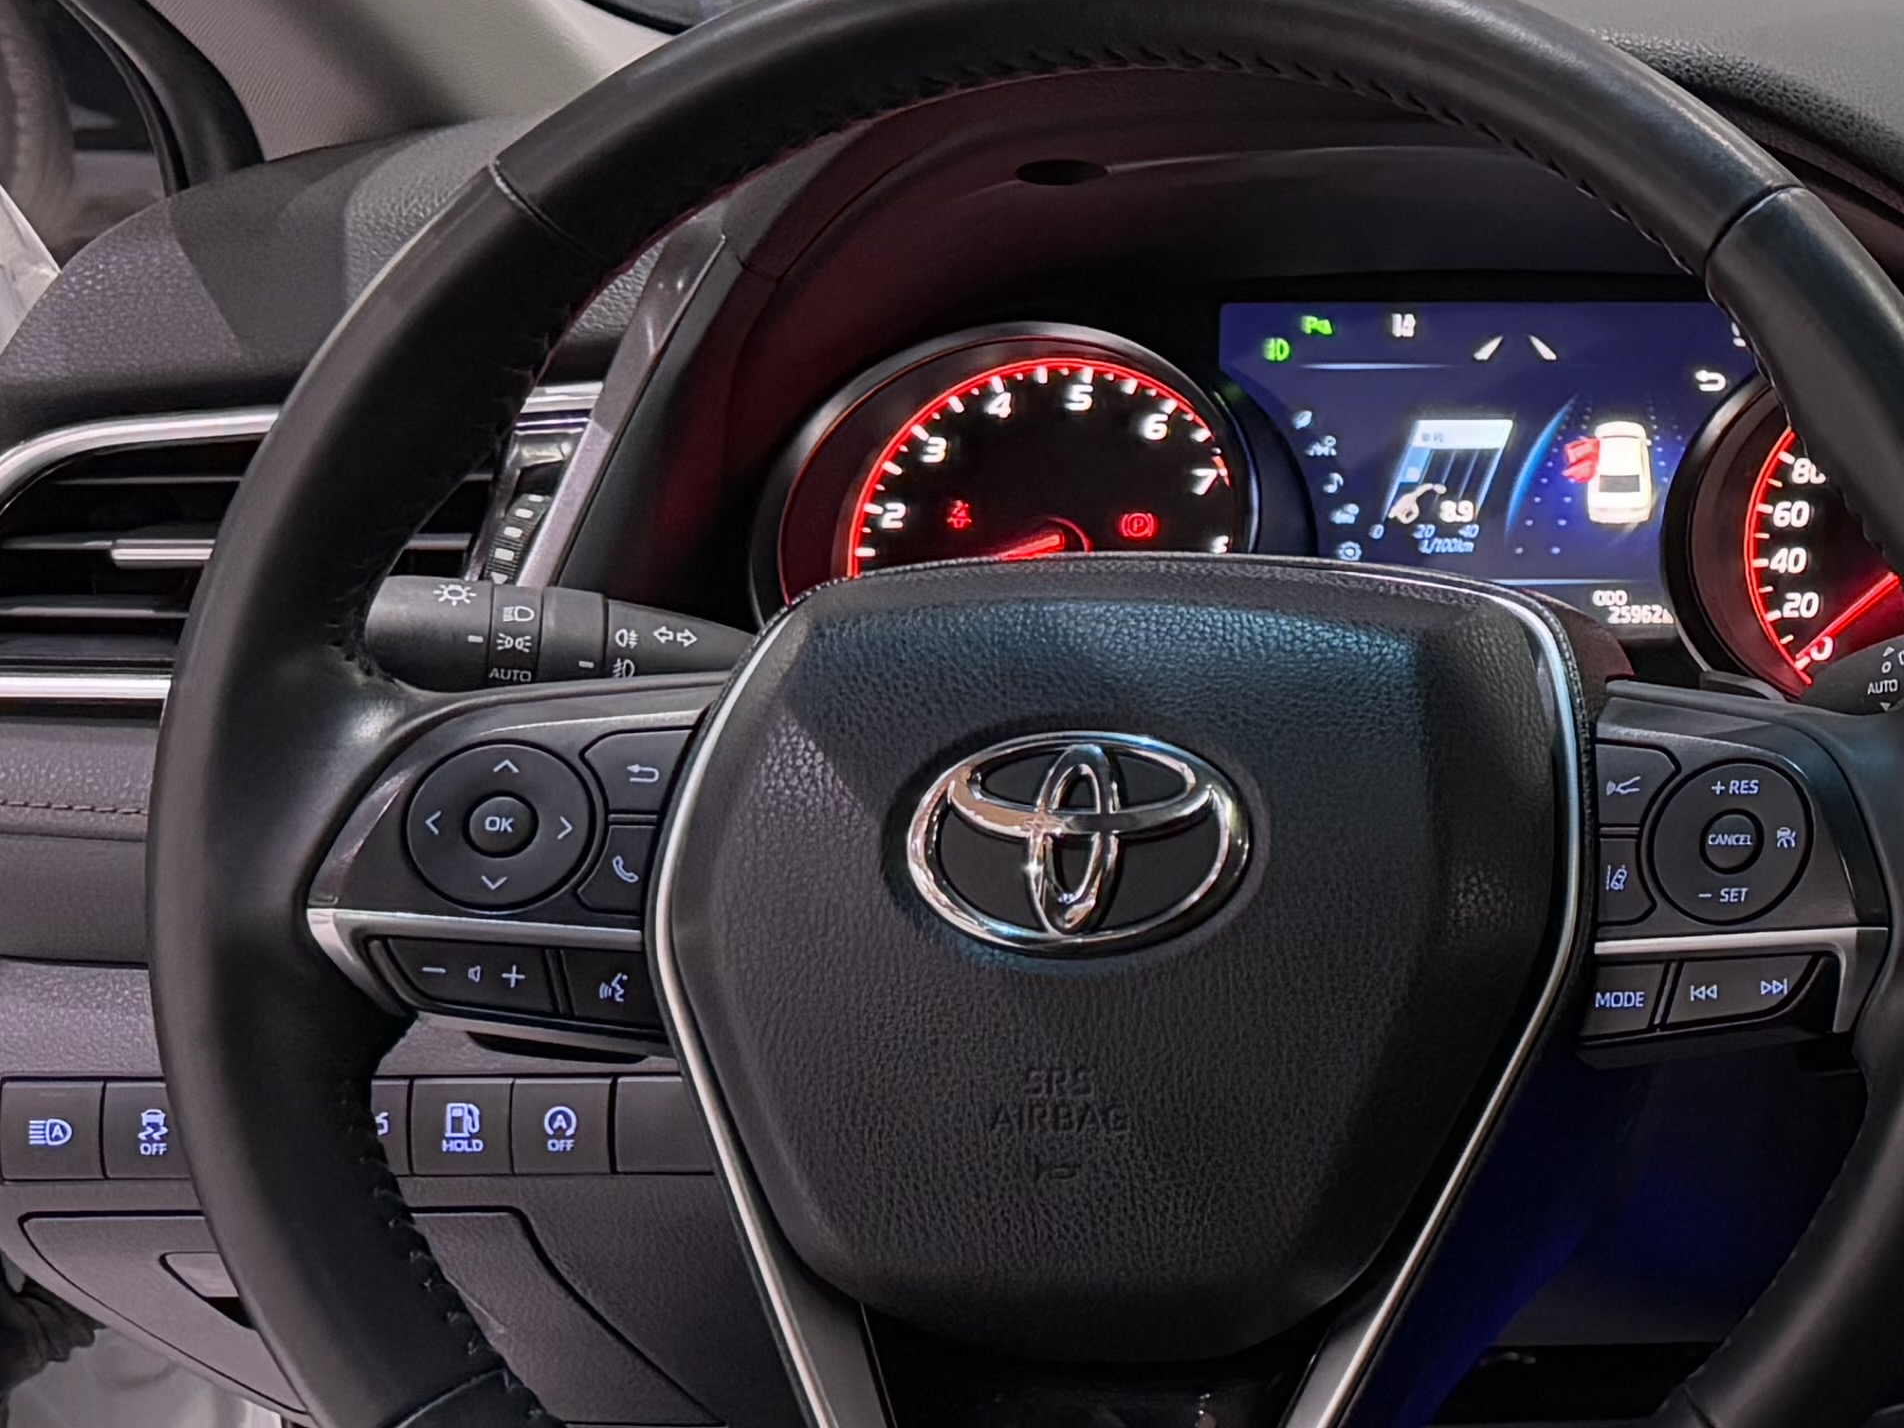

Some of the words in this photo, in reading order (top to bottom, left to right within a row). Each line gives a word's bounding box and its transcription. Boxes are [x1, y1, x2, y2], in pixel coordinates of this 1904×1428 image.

[984, 391, 1012, 419] 4
[1065, 385, 1093, 411] 5
[1143, 413, 1168, 440] 6
[920, 436, 947, 463] 3
[1191, 468, 1217, 495] 7
[880, 502, 906, 529] 2
[1772, 500, 1811, 528] 60
[1768, 547, 1808, 574] 40
[1592, 589, 1628, 606] ODO
[1782, 592, 1819, 619] 20
[1809, 636, 1834, 661] 0
[488, 666, 532, 684] AUTO
[1868, 679, 1897, 694] AUTO
[1729, 779, 1759, 796] RES
[484, 816, 514, 834] OK
[1708, 834, 1751, 845] CANCEL
[1720, 888, 1748, 902] SET
[1596, 992, 1644, 1007] MODE
[1023, 1068, 1096, 1098] SRS
[990, 1102, 1131, 1134] AIRBAG
[139, 1142, 168, 1156] OFF
[441, 1138, 484, 1153] HOLD
[547, 1138, 575, 1152] OFF
